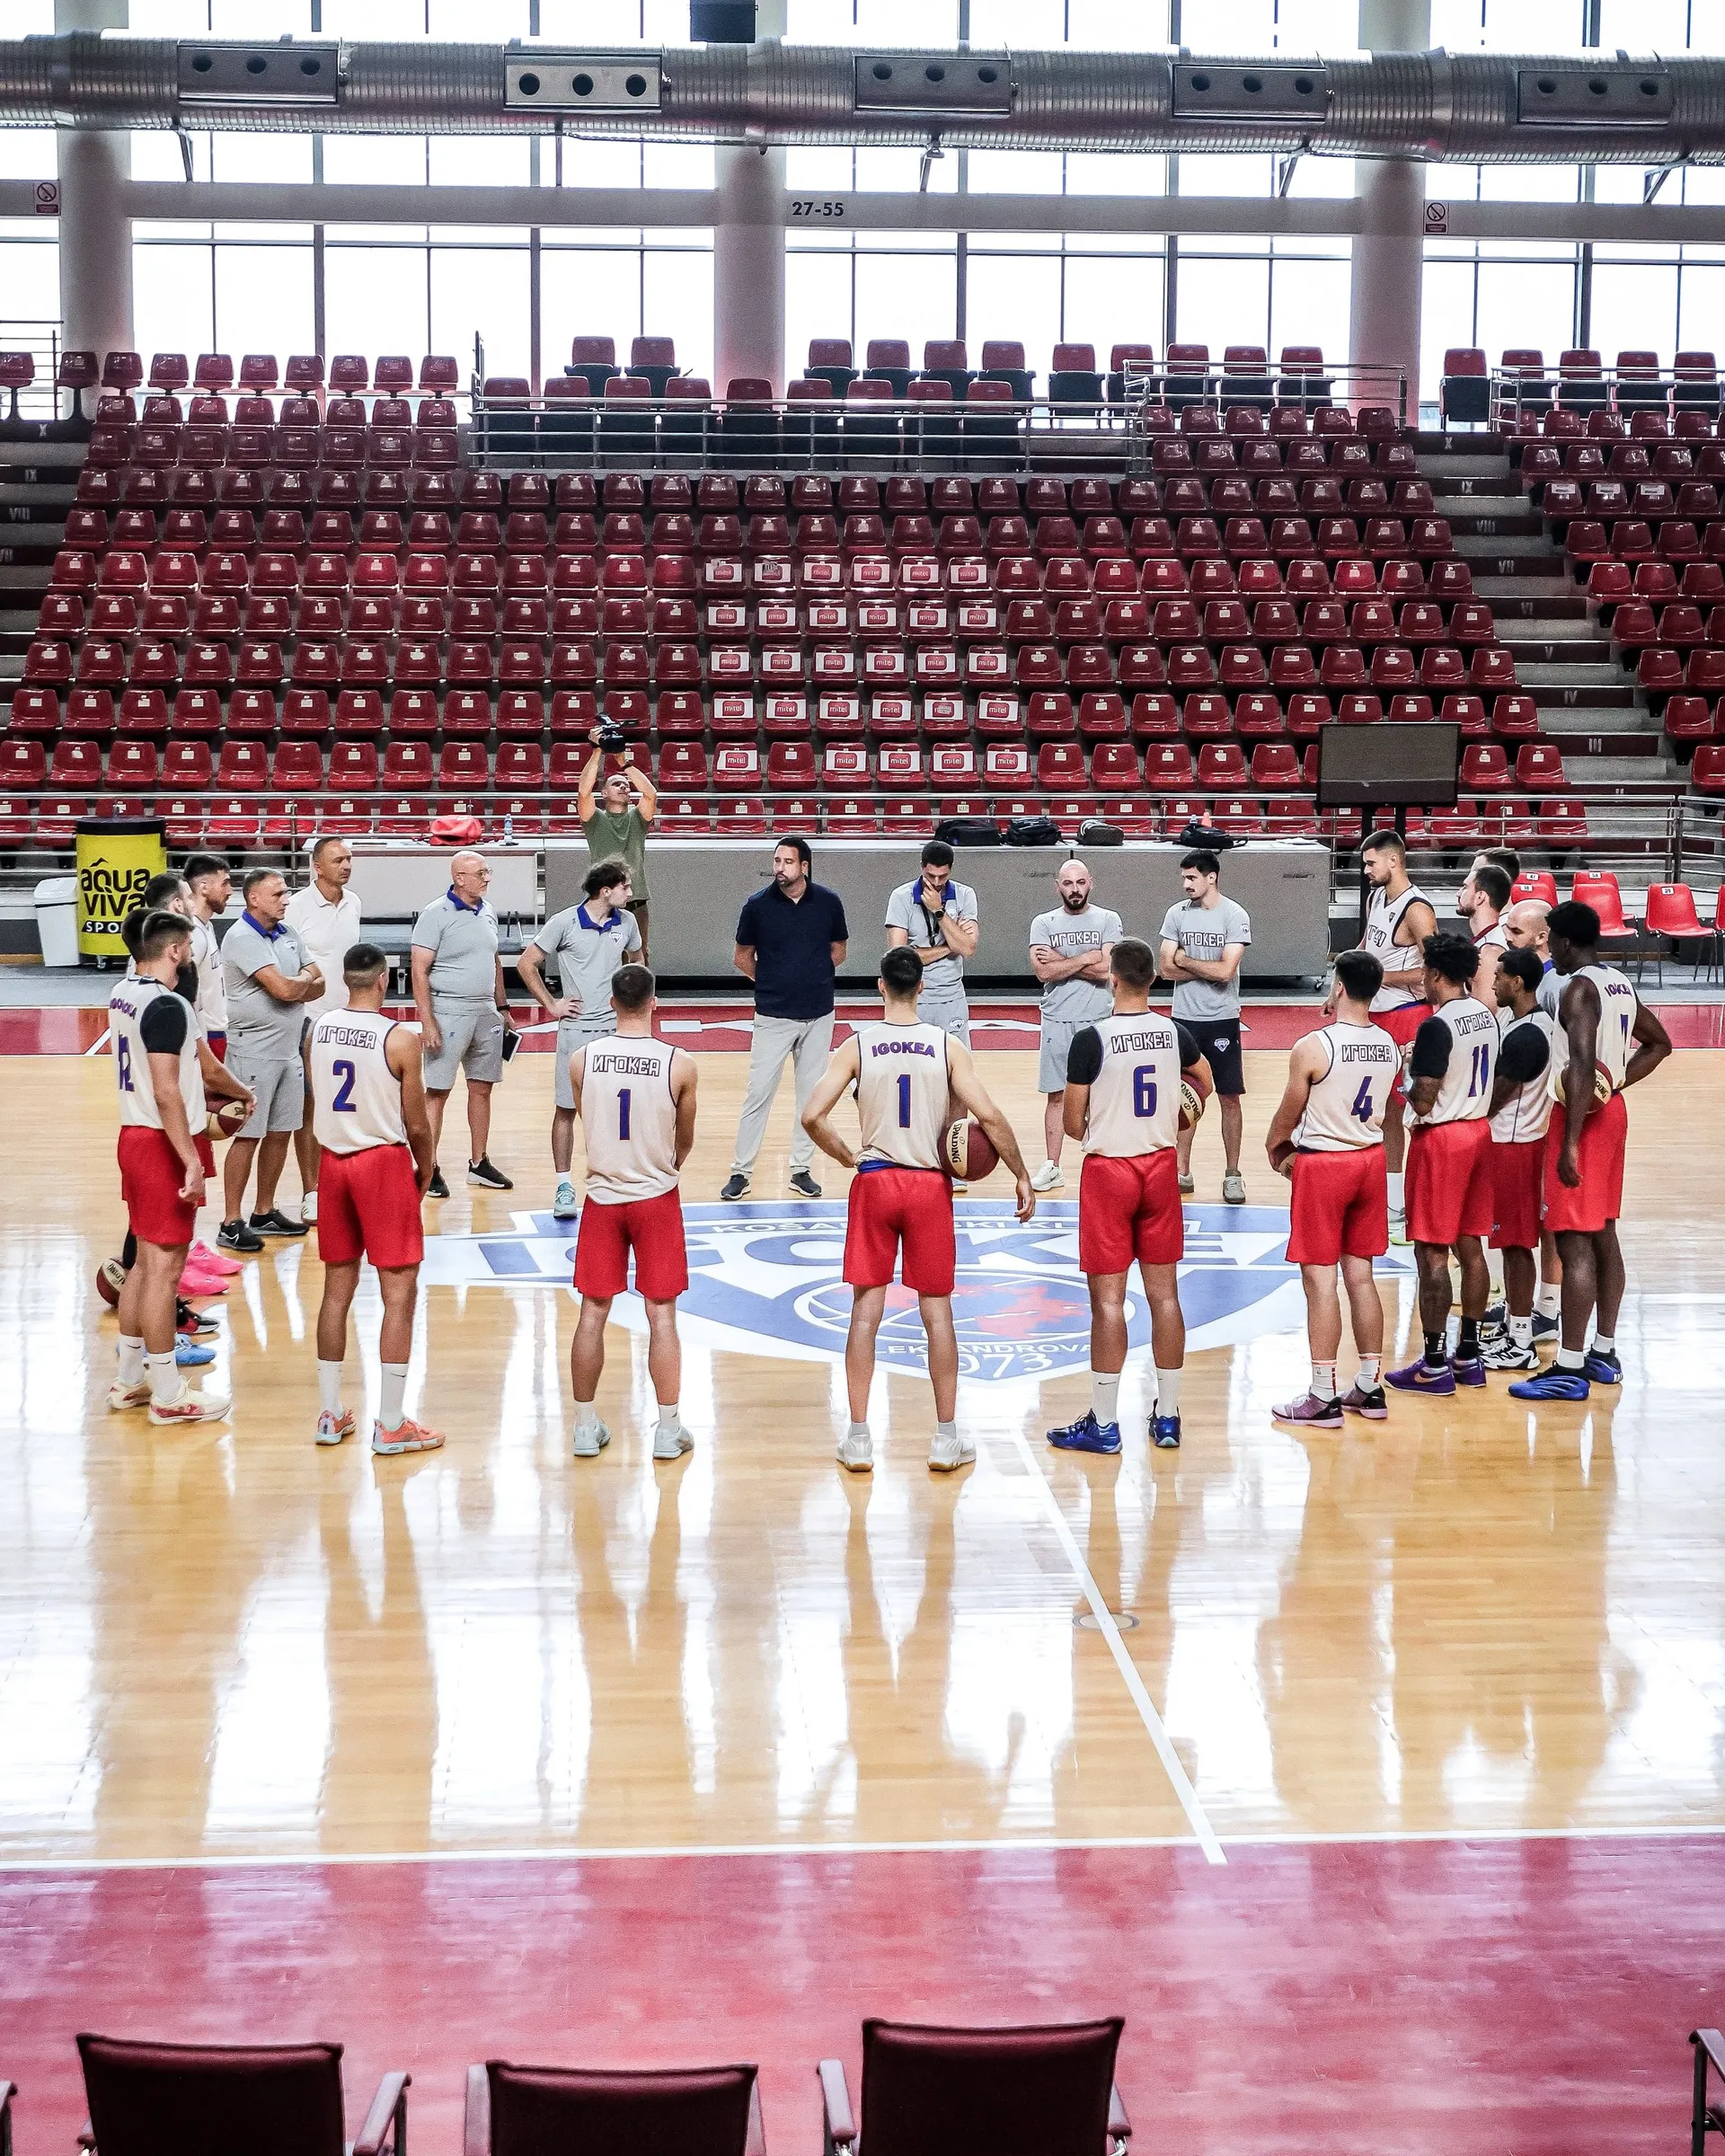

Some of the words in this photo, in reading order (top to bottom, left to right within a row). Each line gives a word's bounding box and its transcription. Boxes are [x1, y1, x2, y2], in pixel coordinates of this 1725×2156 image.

[792, 201, 845, 216] 27-55
[1544, 646, 1553, 660] V
[875, 658, 894, 667] mitel
[1564, 690, 1578, 704] IV
[723, 703, 743, 712] mitel
[776, 704, 796, 713] mitel
[828, 704, 848, 713] mitel
[881, 705, 901, 714] mitel
[988, 705, 1008, 714] mitel
[1588, 738, 1602, 753] III
[727, 755, 747, 764] mitel
[836, 756, 855, 765] mitel
[889, 756, 909, 765] mitel
[942, 756, 963, 765] mitel
[996, 756, 1017, 765] mitel
[81, 869, 150, 893] aqua
[84, 893, 146, 916] viva
[85, 922, 120, 933] SPO
[1050, 931, 1100, 948] ИГОКЕА
[1181, 931, 1225, 947] ИГОКЕА
[317, 1026, 377, 1049] ИГОКЕА
[1110, 1030, 1173, 1054] ИГОКЕА
[871, 1041, 935, 1058] IGOKEA
[1341, 1044, 1393, 1062] ИГОКЕА
[593, 1055, 661, 1076] ИГОКЕА
[1467, 1043, 1490, 1098] 11
[332, 1059, 357, 1112] 2
[1133, 1065, 1157, 1118] 6
[896, 1074, 911, 1128] 1
[1350, 1075, 1373, 1123] 4
[617, 1088, 631, 1140] 1
[951, 1123, 962, 1163] SPALDING
